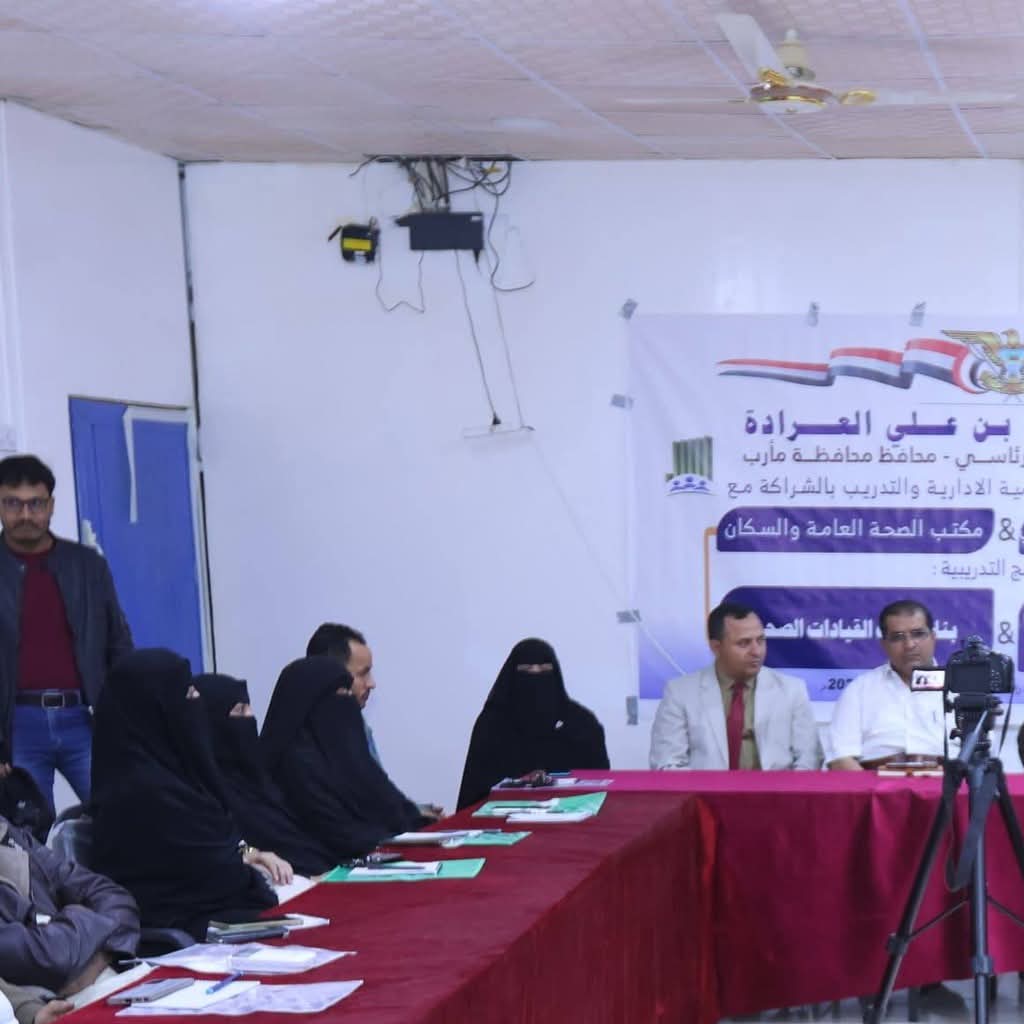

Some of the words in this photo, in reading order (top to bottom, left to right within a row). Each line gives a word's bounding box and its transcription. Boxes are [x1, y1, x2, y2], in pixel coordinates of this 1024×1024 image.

[744, 410, 871, 441] العرادة
[973, 417, 1011, 443] بن
[742, 440, 786, 464] مأرب
[792, 445, 873, 464] محافظة
[878, 445, 937, 464] محافظ
[728, 481, 753, 499] مع
[759, 477, 835, 500] بالشراكة
[843, 478, 920, 500] والتدريب
[927, 478, 993, 501] الادارية
[724, 518, 800, 541] والسكان
[806, 518, 863, 541] العامة
[869, 517, 923, 537] الصحة
[930, 521, 983, 542] مكتب
[998, 517, 1016, 542] &
[763, 618, 804, 638] الصح
[807, 617, 874, 643] القيادات
[998, 621, 1015, 645] &
